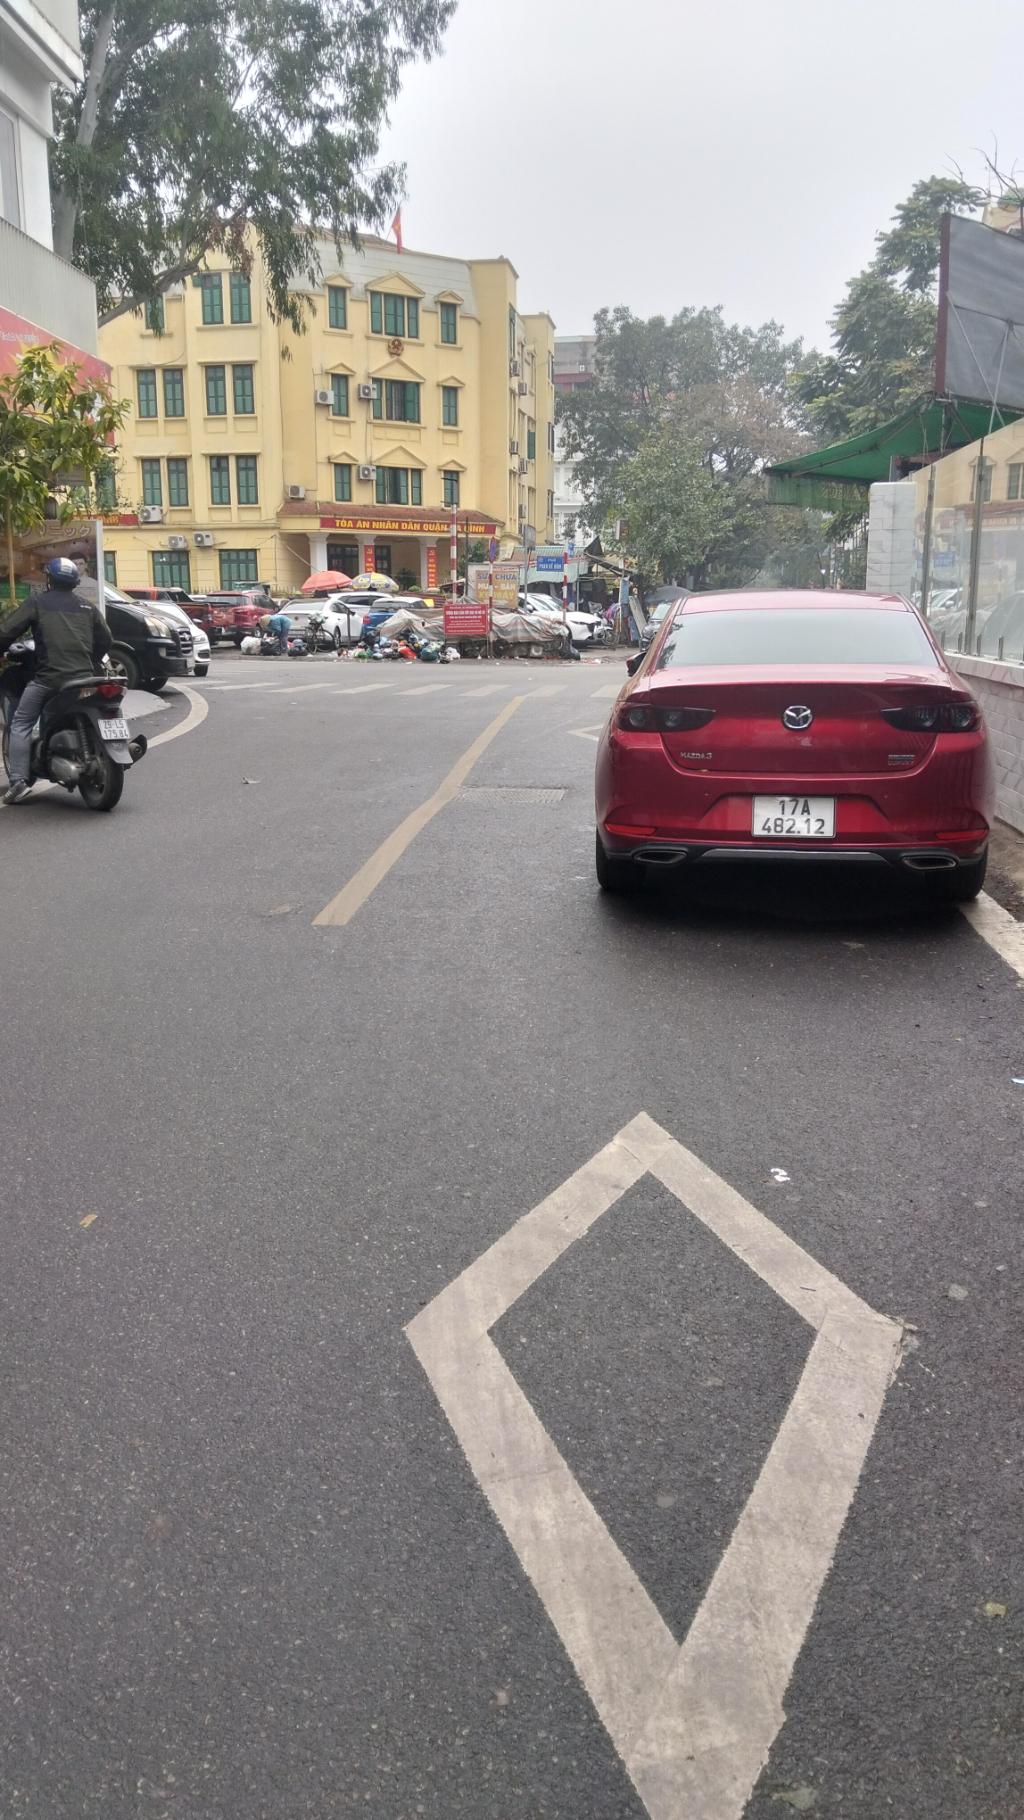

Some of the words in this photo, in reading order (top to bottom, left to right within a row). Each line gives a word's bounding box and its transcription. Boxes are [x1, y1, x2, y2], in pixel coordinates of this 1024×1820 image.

[335, 518, 353, 528] TÒA
[372, 520, 399, 530] NHÂN
[401, 521, 420, 531] DÂN
[422, 522, 448, 533] QUẬN
[779, 798, 811, 816] 17A
[762, 817, 825, 835] 482.12
